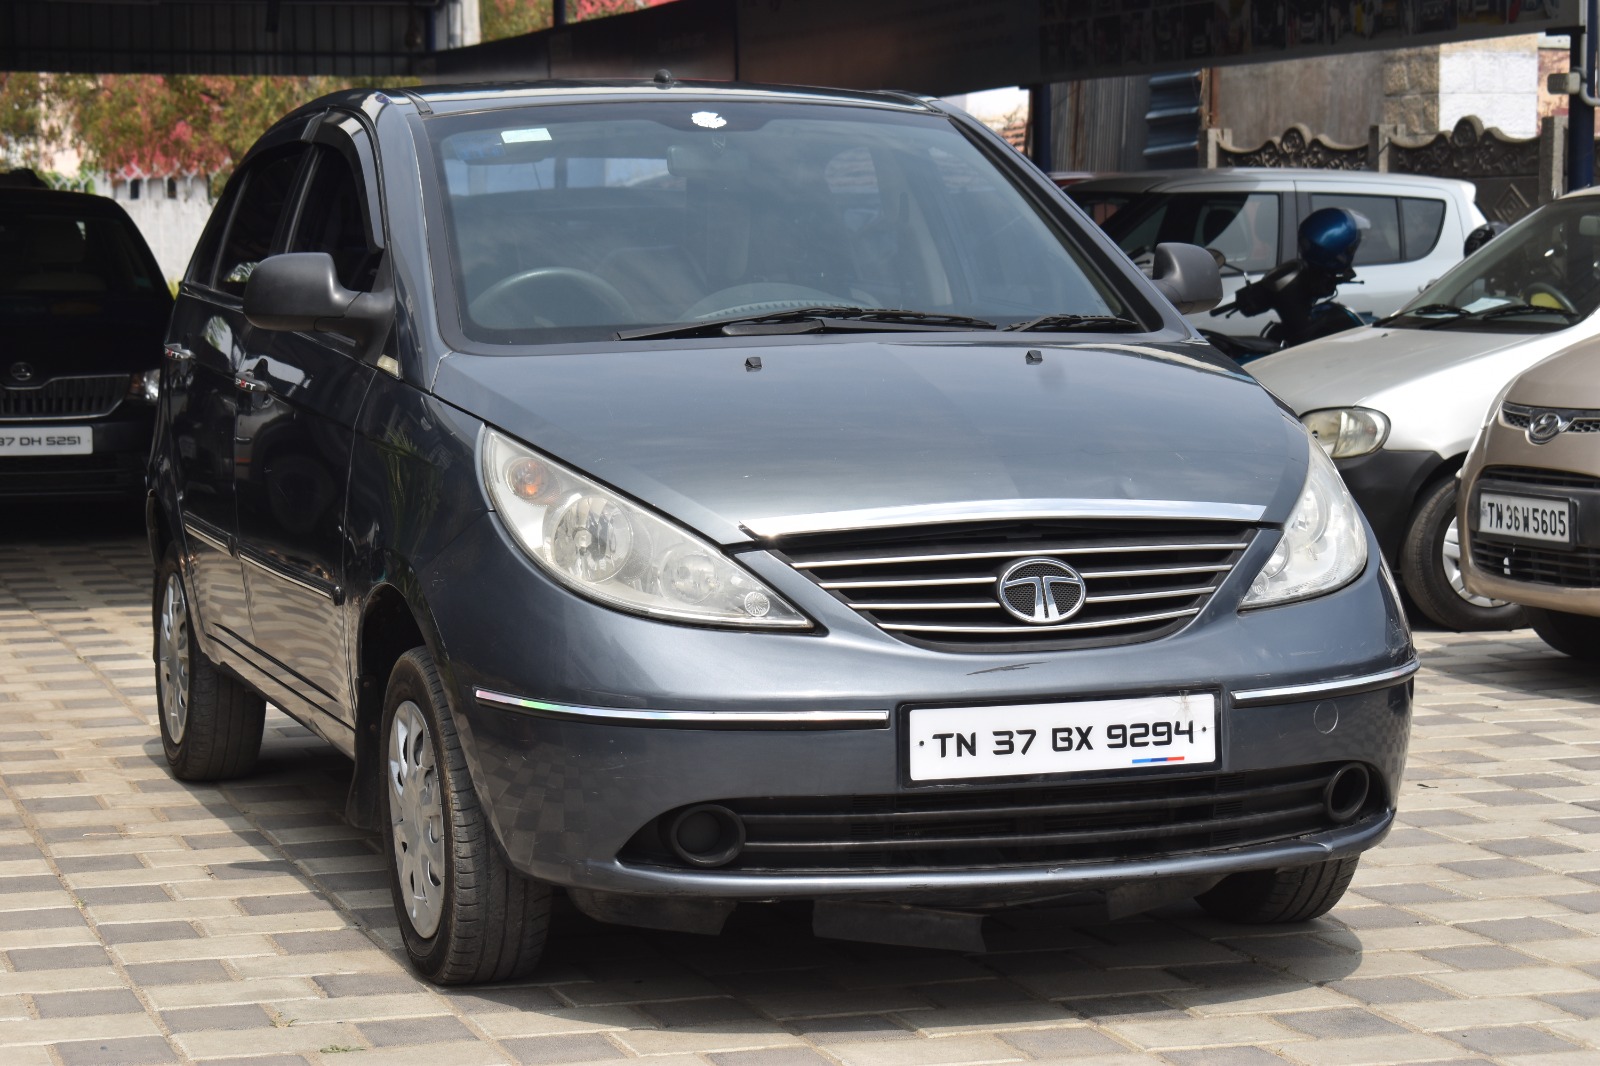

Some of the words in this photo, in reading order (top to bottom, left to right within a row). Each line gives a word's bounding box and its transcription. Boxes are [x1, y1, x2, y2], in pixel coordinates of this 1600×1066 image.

[19, 437, 42, 446] DH
[46, 436, 81, 446] 5251
[932, 732, 976, 758] TN
[992, 728, 1036, 756] 37
[1051, 725, 1094, 753] BX
[1106, 720, 1193, 749] 9294
